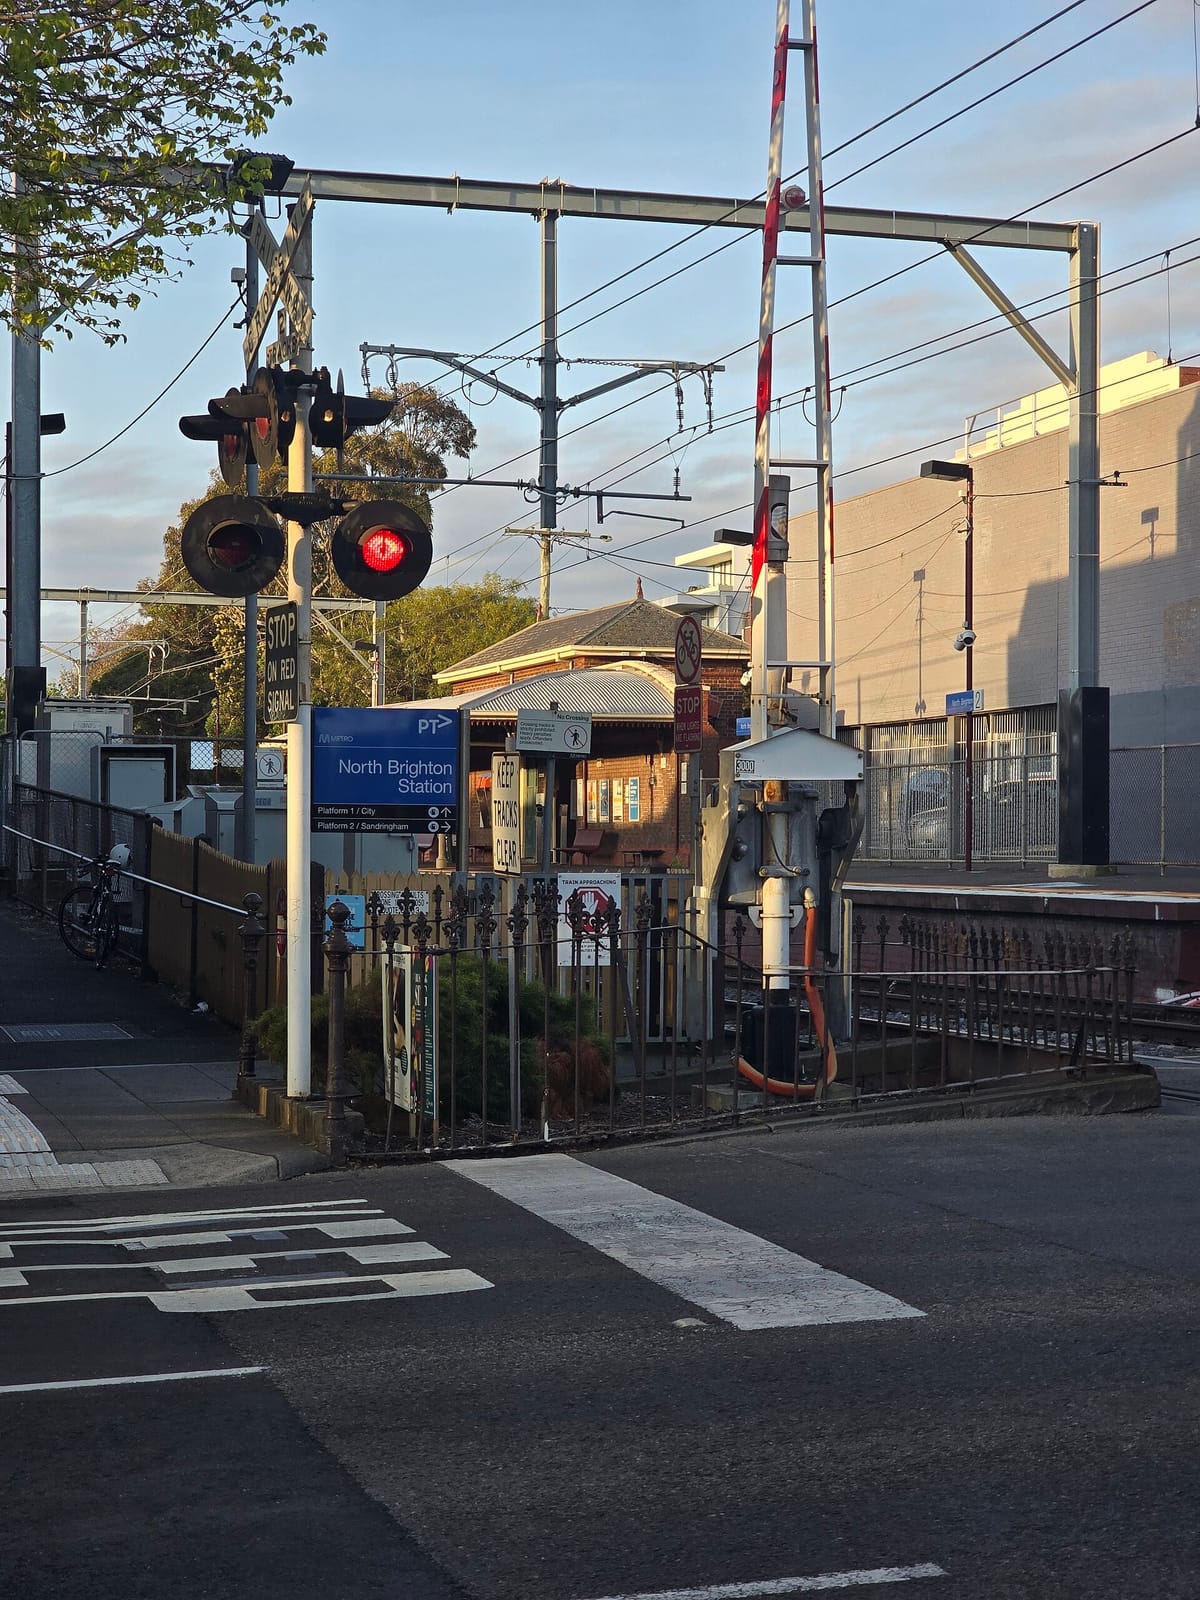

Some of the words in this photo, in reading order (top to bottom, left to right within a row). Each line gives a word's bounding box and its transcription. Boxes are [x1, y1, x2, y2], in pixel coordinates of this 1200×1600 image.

[267, 612, 295, 650] STOP
[267, 660, 277, 683] ON
[280, 657, 295, 681] RED
[267, 688, 294, 713] SIGNAL
[677, 697, 699, 713] STOP
[975, 691, 981, 708] 2
[565, 714, 590, 722] Crossing
[339, 759, 382, 774] North
[388, 759, 453, 779] Brighton
[496, 761, 515, 789] KEEP
[736, 760, 754, 772] 3000
[398, 778, 452, 794] Station
[317, 806, 349, 815] Platform
[361, 807, 376, 817] City
[494, 800, 518, 829] TRACKS
[317, 821, 349, 831] Platform
[361, 821, 409, 832] Sandringham
[496, 838, 518, 867] CLEAR
